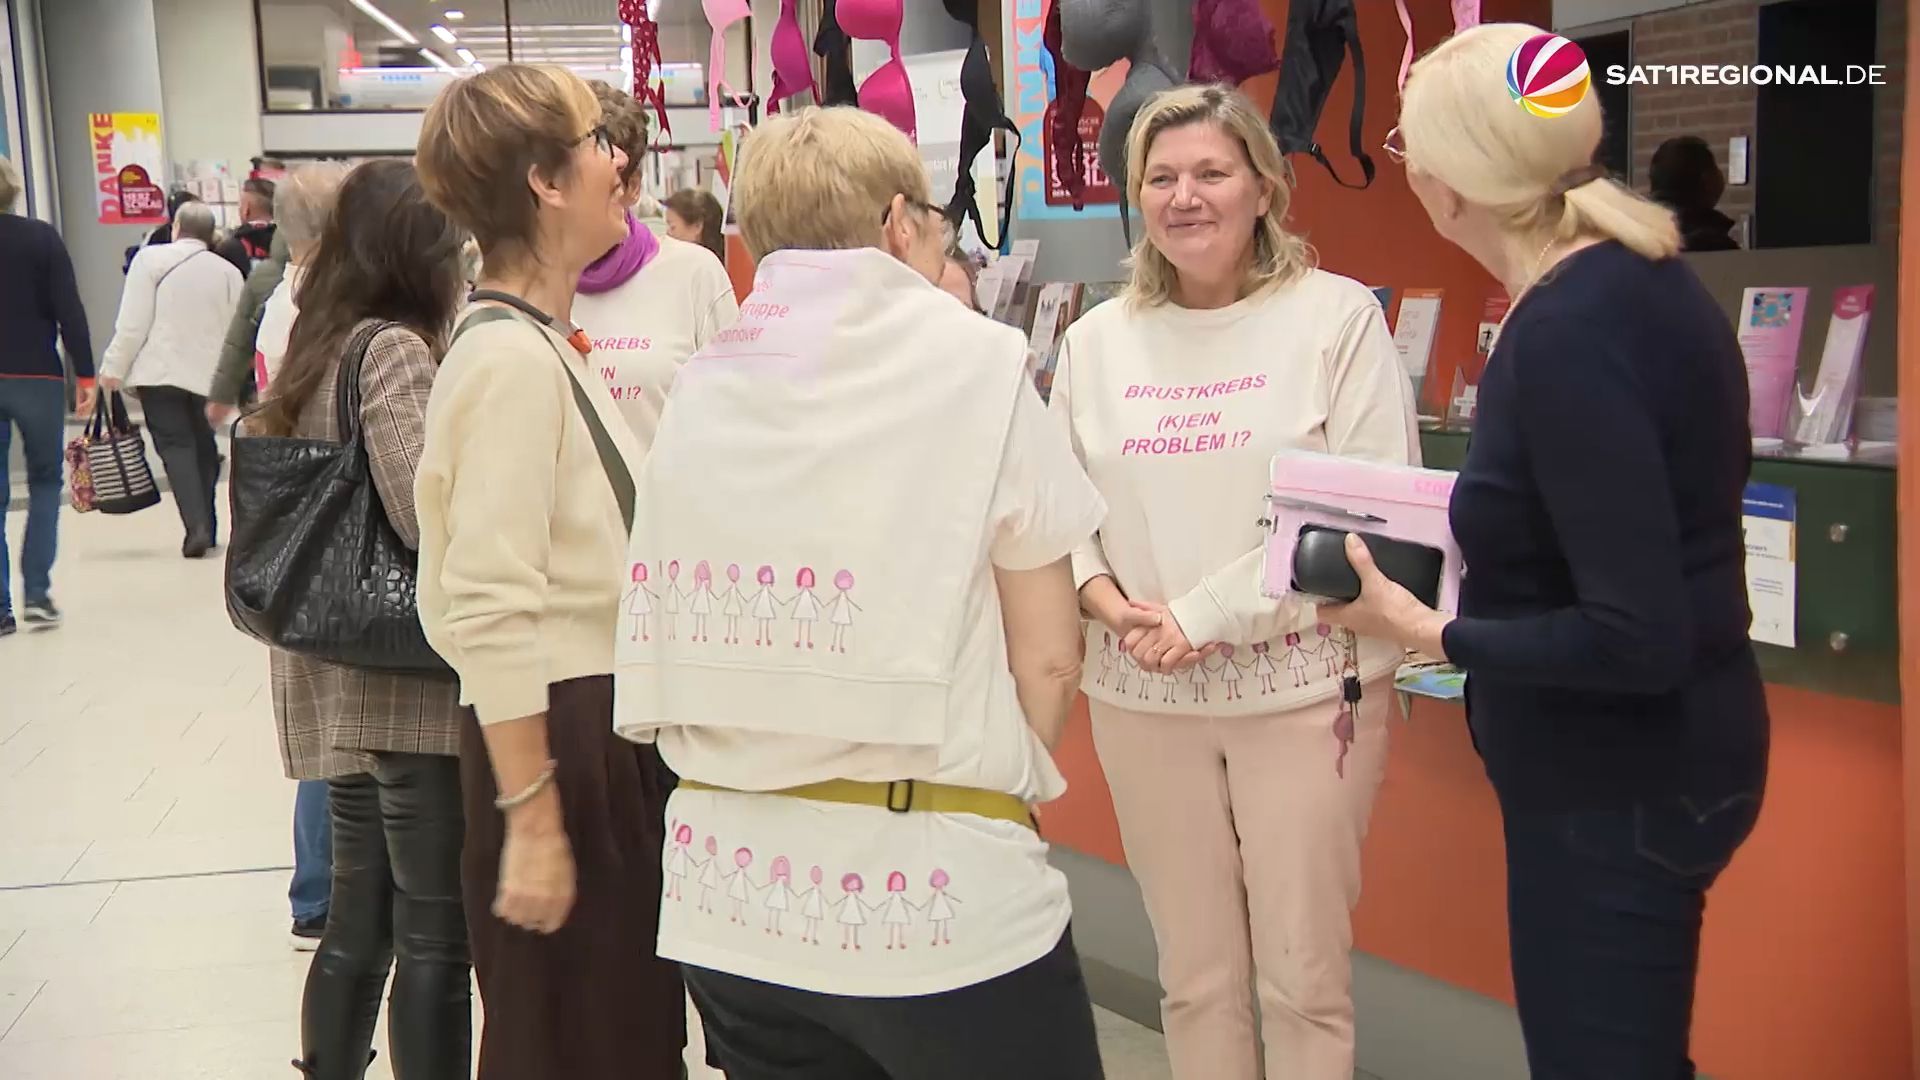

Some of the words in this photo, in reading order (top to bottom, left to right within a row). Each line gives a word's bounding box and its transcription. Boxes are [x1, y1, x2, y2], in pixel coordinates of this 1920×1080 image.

[93, 113, 120, 217] DANKE
[591, 337, 651, 350] KREBS
[1124, 373, 1268, 401] BRUSTKREBS
[1157, 411, 1222, 433] (K)EIN
[1121, 433, 1226, 456] PROBLEM
